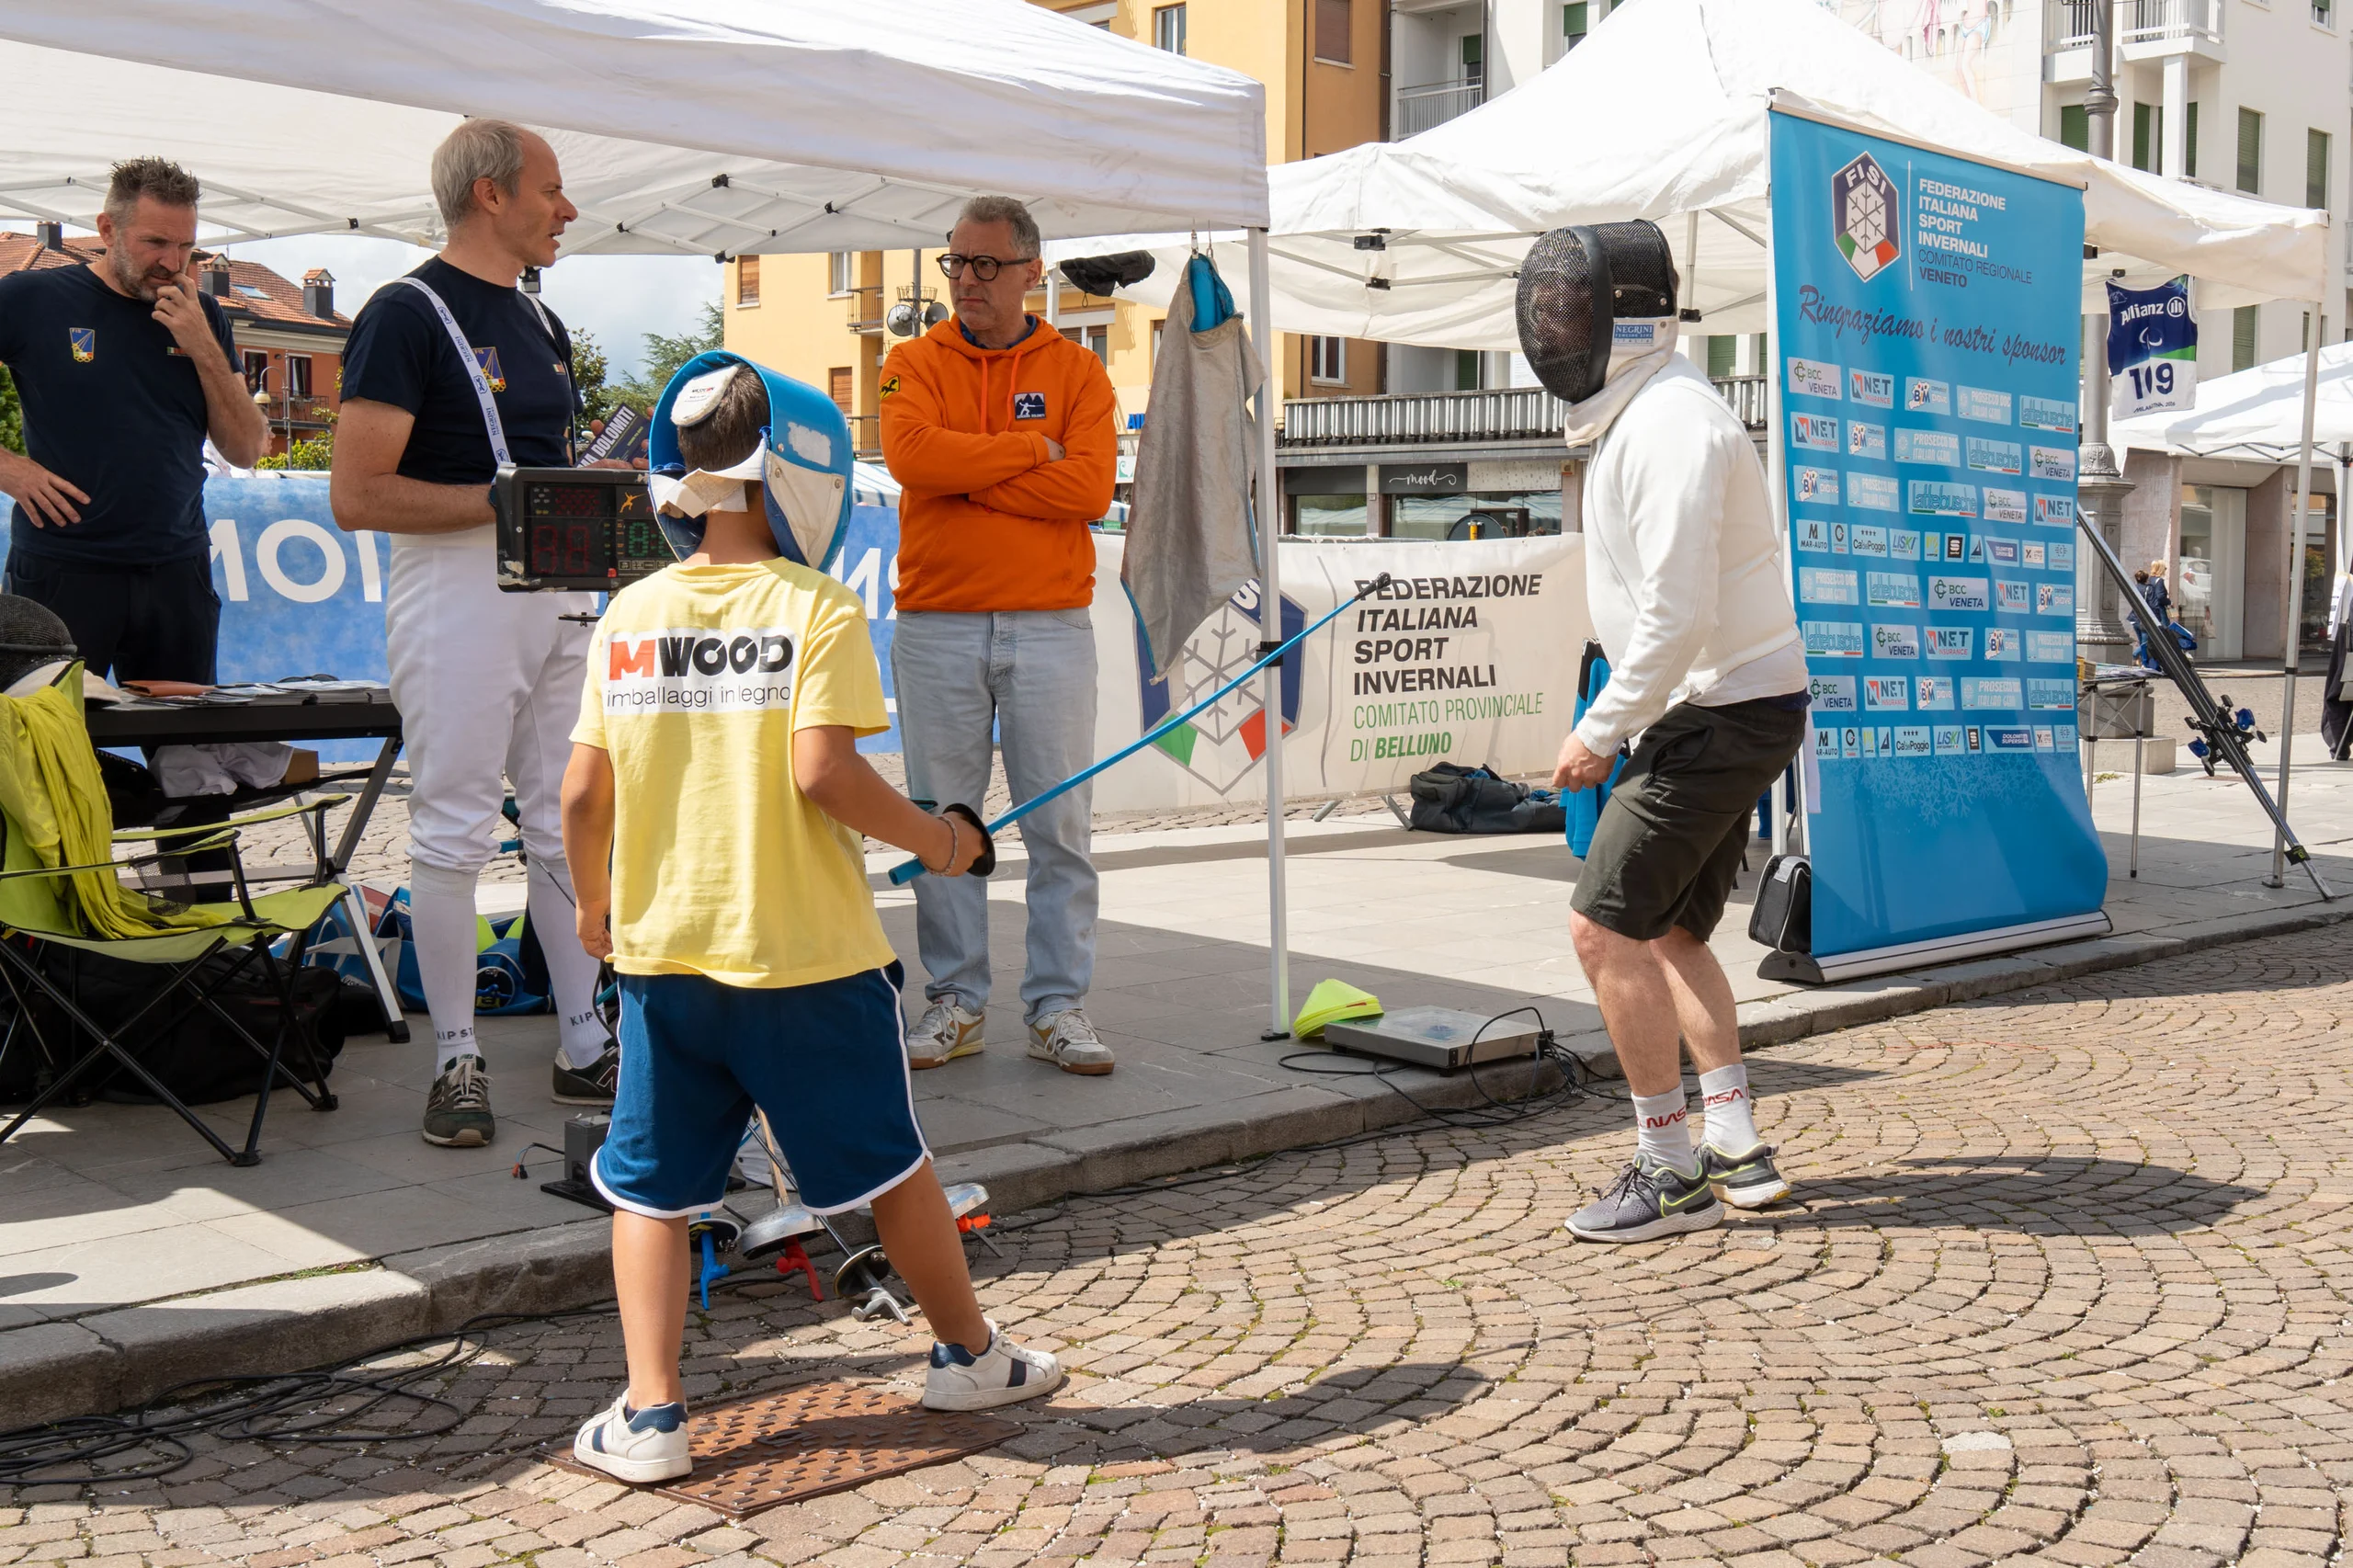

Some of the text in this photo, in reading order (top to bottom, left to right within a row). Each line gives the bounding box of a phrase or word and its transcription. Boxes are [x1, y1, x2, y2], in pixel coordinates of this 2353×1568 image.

[1845, 163, 1887, 195] FISI
[1919, 178, 2006, 210] FEDERAZIONE
[1919, 196, 1979, 222] ITALIANA
[1918, 213, 1963, 235] SPORT
[1918, 231, 1988, 258] INVERNALI
[1918, 248, 2032, 285] COMITATO REGIONALE
[1919, 267, 1968, 288] VENETO
[2120, 302, 2165, 325] Allianz
[1616, 325, 1653, 334] NEGRINI
[1799, 284, 2066, 367] Ringraziamo i nostri sponsor
[1807, 368, 1823, 381] BCC
[1808, 382, 1838, 396] VENETA
[1864, 376, 1891, 395] NET
[590, 405, 636, 458] DOLOMITI
[1811, 418, 1836, 438] NET
[2045, 455, 2059, 465] BCC
[2045, 467, 2070, 478] VENETA
[1998, 496, 2011, 506] BCC
[2048, 500, 2071, 517] NET
[1998, 510, 2022, 520] VENETA
[1801, 540, 1827, 550] MAR-AUTO
[1354, 574, 1542, 600] FEDERAZIONE
[1949, 585, 1966, 595] BCC
[2006, 584, 2027, 600] NET
[1949, 597, 1984, 608] VENETA
[1357, 606, 1478, 632] ITALIANA
[1887, 632, 1901, 642] BCC
[1938, 631, 1969, 647] NET
[608, 634, 794, 681] MWOOD
[1354, 637, 1449, 665] SPORT
[1888, 646, 1915, 656] VENETA
[1354, 665, 1496, 696] INVERNALI
[1823, 684, 1837, 694] BCC
[1881, 680, 1905, 697] NET
[607, 686, 712, 708] imballaggi
[738, 684, 790, 706] legno
[1824, 698, 1853, 708] VENETA
[1354, 692, 1543, 729] COMITATO PROVINCIALE
[1350, 732, 1452, 762] DI BELLUNO
[1937, 731, 1961, 744] LISKI
